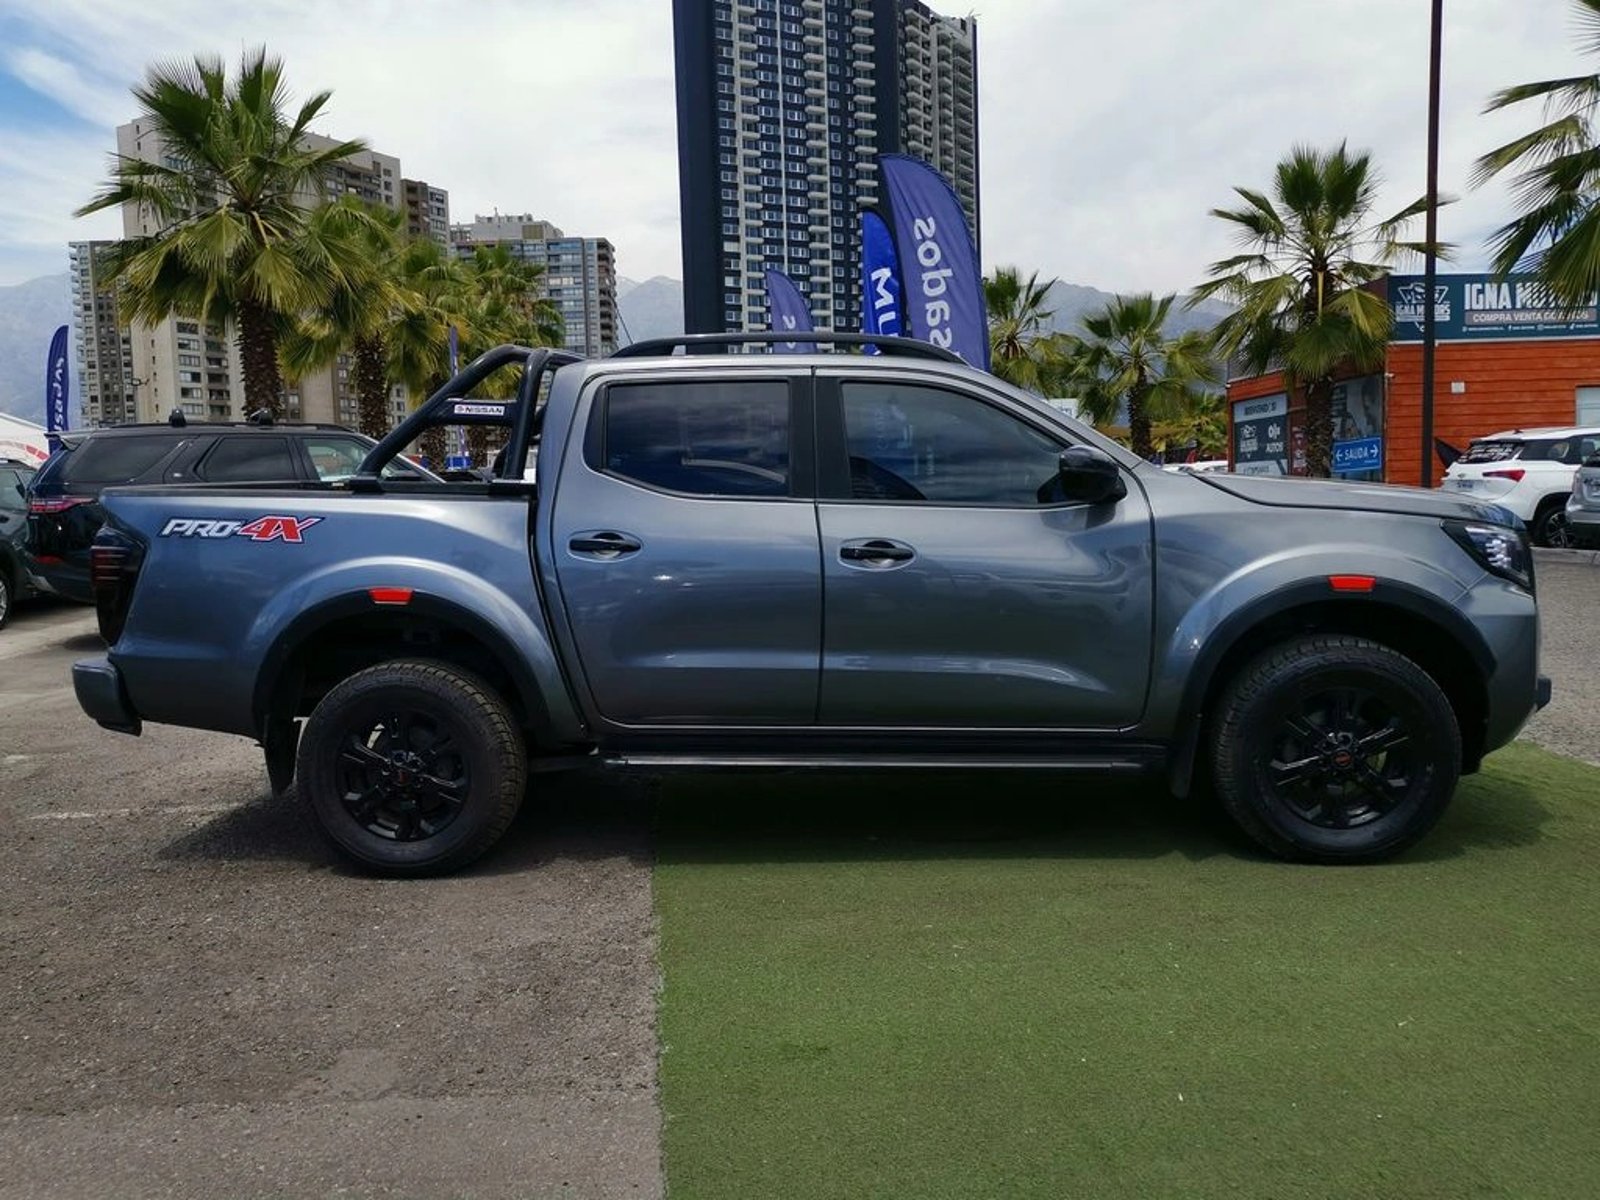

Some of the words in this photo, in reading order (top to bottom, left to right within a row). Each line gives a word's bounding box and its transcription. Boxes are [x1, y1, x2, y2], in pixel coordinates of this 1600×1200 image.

[1464, 284, 1512, 310] IGNA
[1472, 313, 1511, 323] COMPRA
[1513, 312, 1542, 321] VENTA
